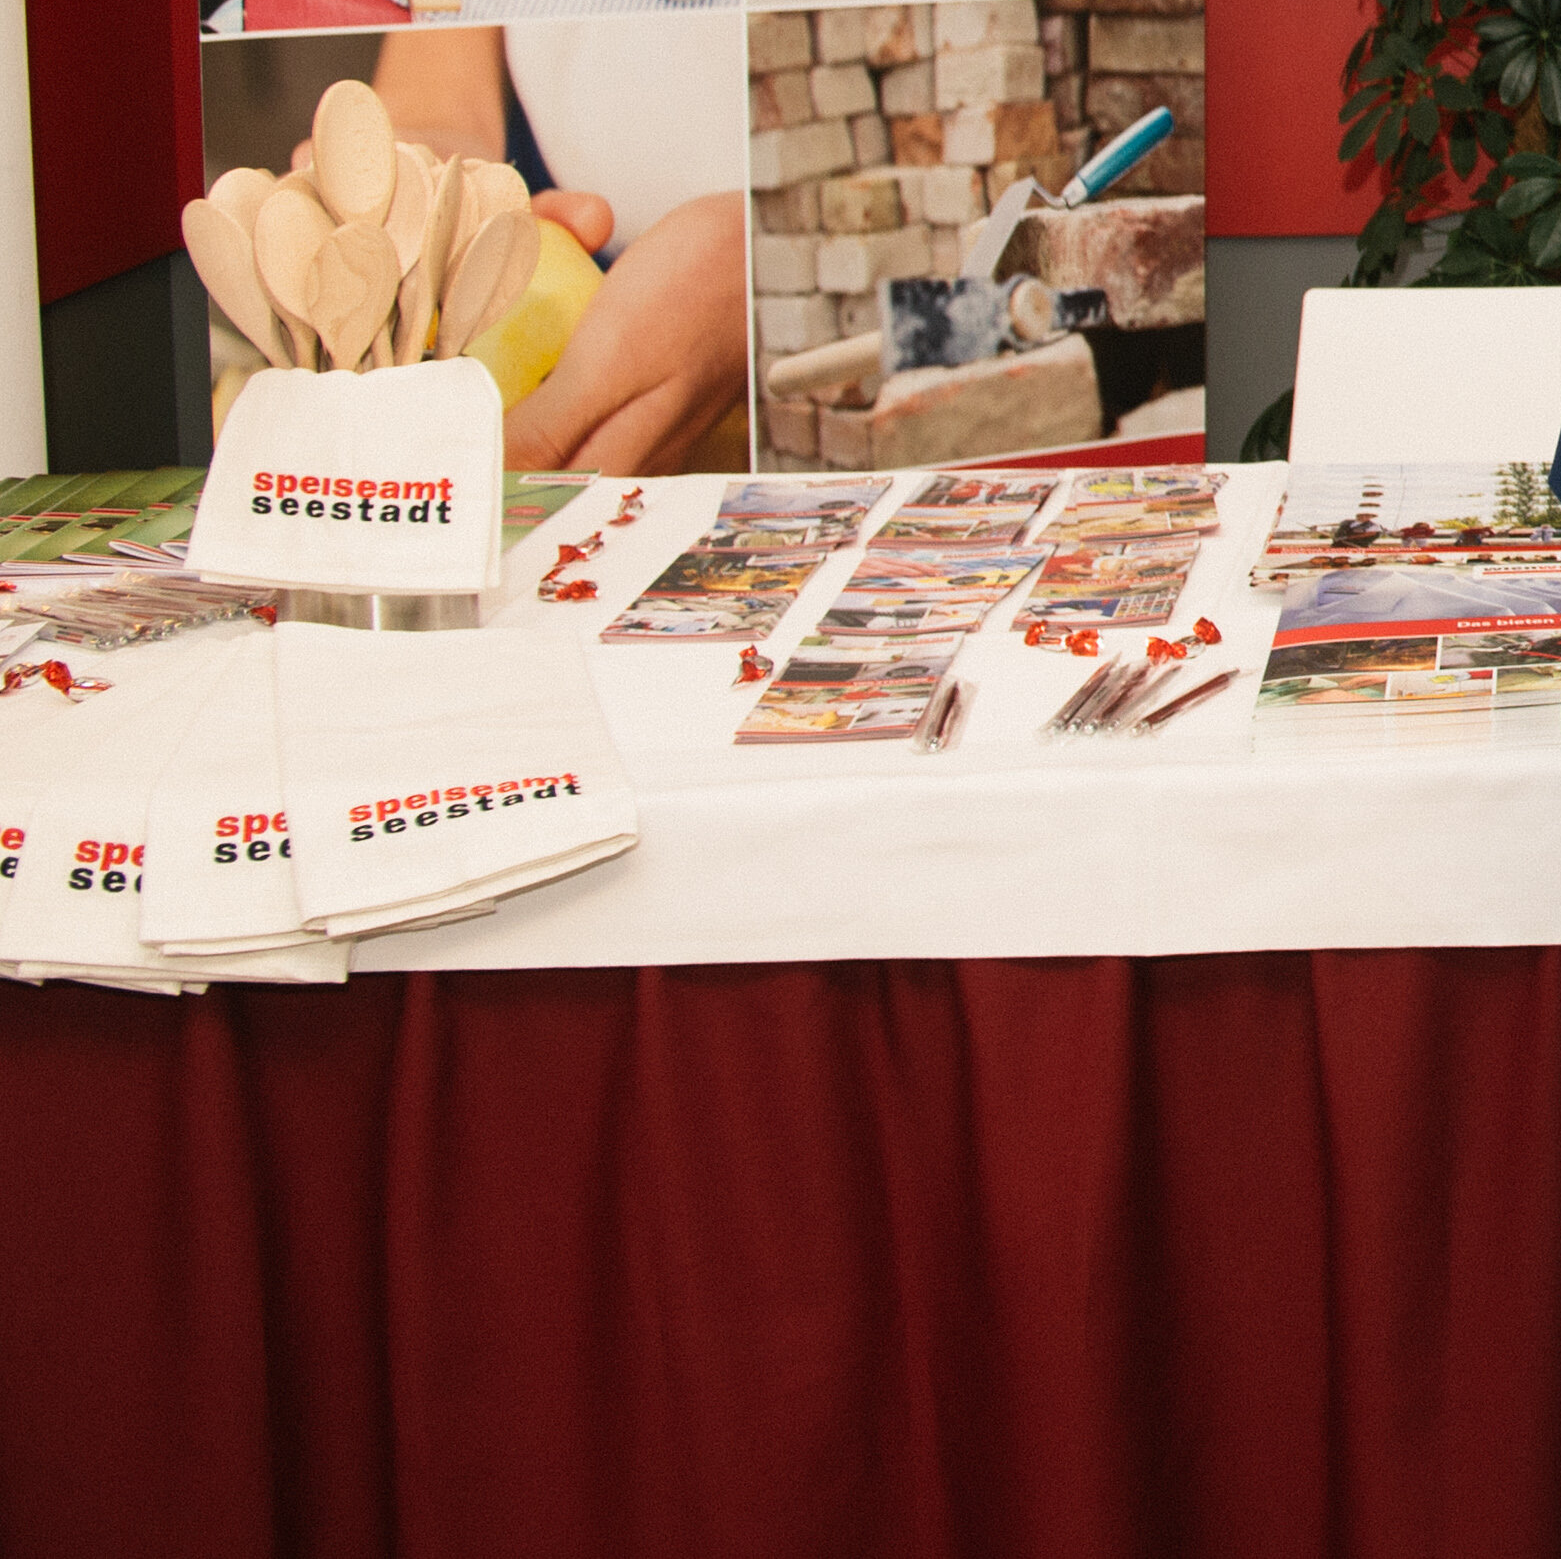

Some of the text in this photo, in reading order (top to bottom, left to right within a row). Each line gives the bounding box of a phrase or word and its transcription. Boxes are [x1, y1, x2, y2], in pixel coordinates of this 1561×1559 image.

[253, 472, 453, 501] speiseamt
[251, 495, 452, 524] seestadt
[349, 772, 580, 822] speiseamt
[351, 783, 581, 842] seestadt
